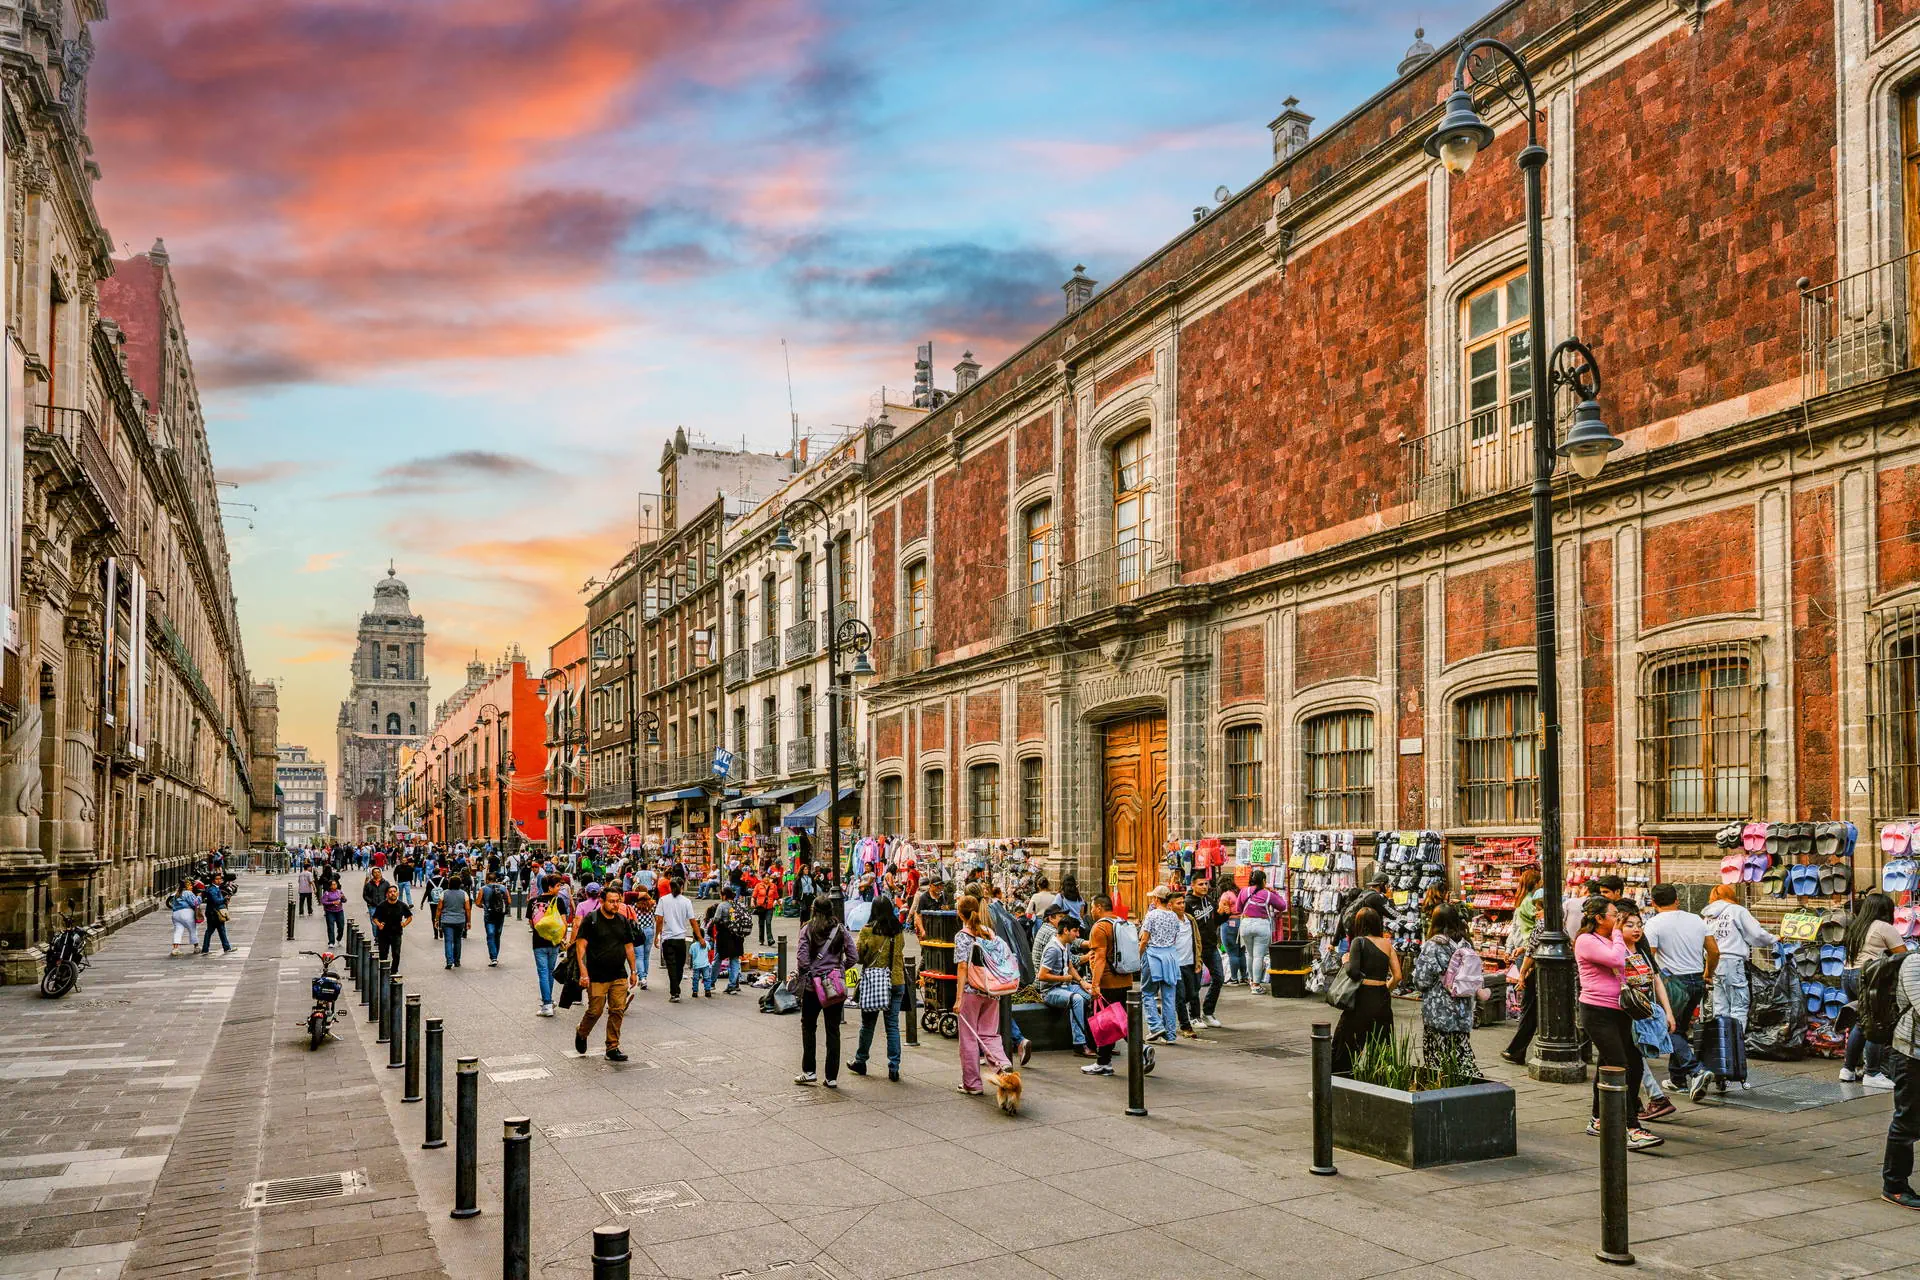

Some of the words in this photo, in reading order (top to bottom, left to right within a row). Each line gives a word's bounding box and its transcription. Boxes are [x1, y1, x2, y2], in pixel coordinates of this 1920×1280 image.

[716, 748, 732, 764] WC
[1853, 779, 1867, 792] A
[1109, 872, 1118, 885] 10
[1783, 920, 1815, 937] 50
[848, 969, 858, 984] 10
